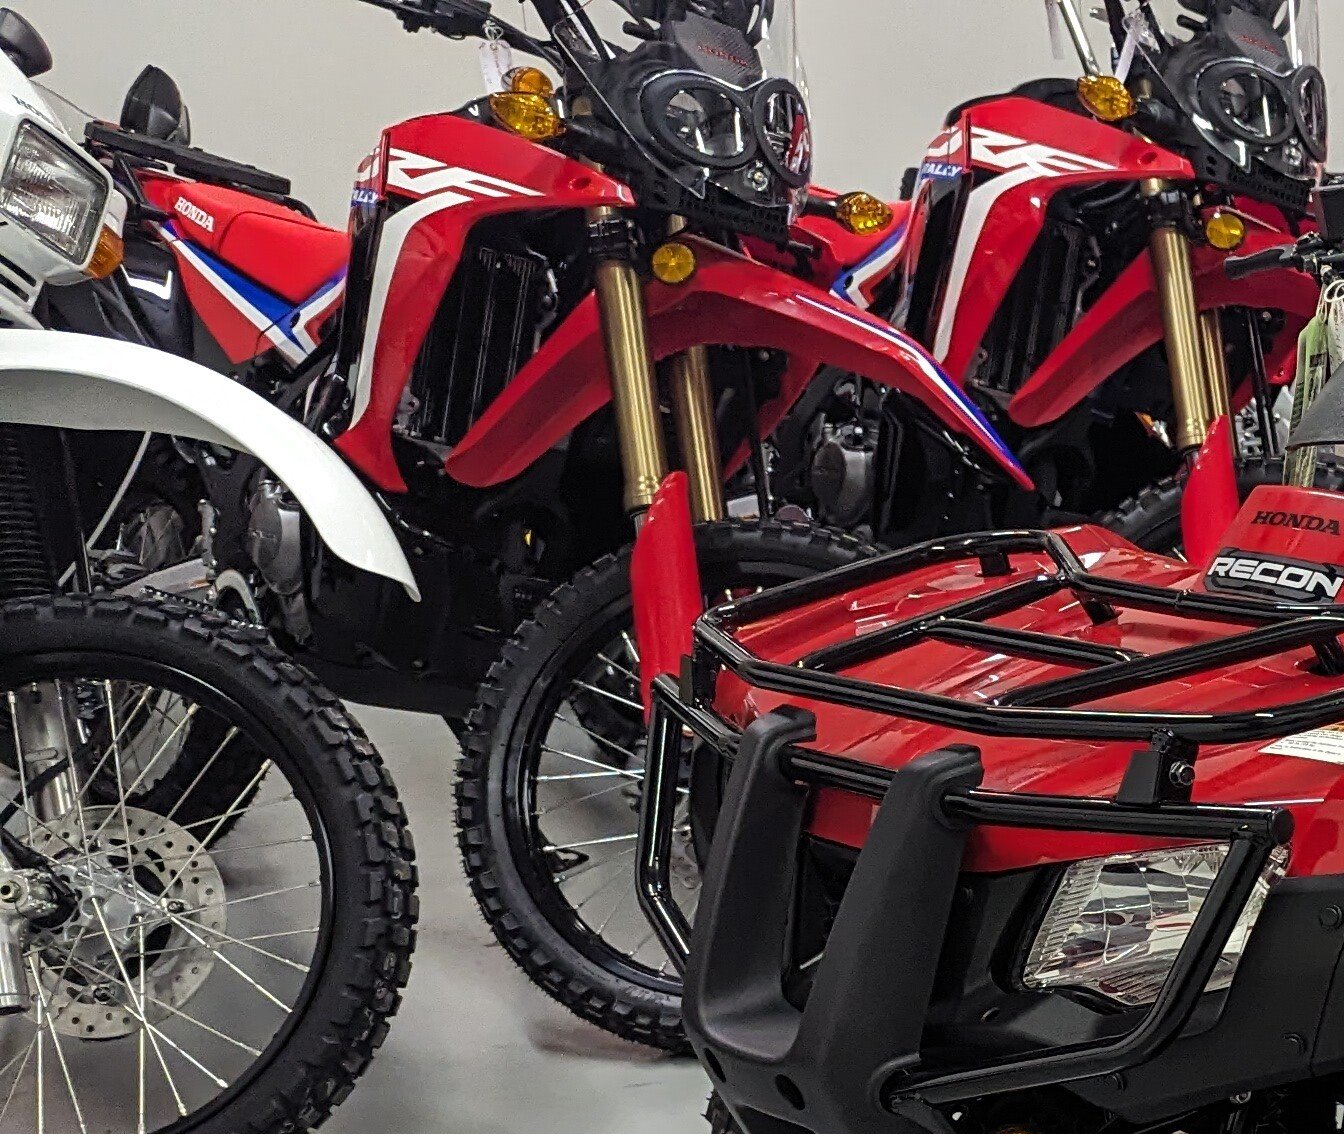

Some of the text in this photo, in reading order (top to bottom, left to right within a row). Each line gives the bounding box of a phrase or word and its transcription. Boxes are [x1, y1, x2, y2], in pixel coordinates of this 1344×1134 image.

[174, 196, 215, 232] HONDA
[1251, 510, 1341, 536] HONDA
[1207, 556, 1344, 597] RECON
